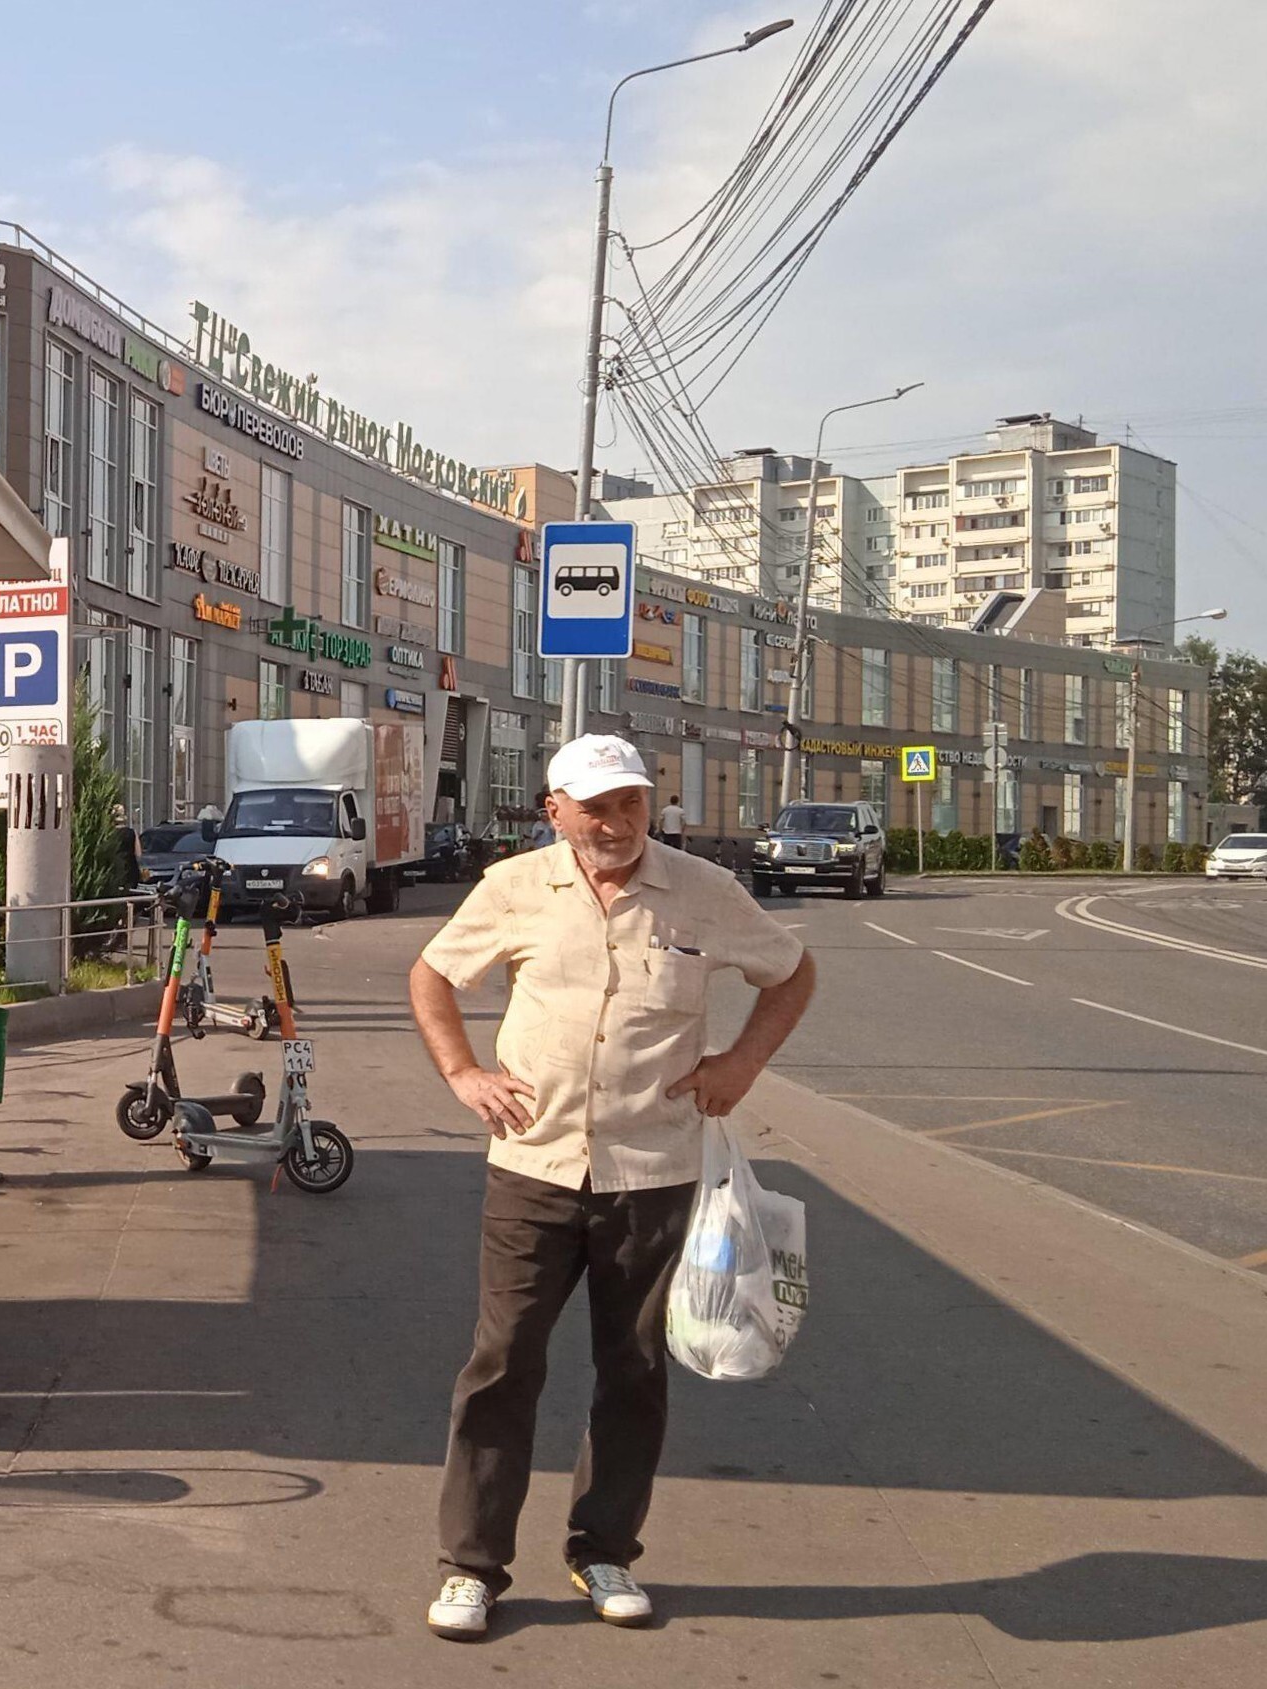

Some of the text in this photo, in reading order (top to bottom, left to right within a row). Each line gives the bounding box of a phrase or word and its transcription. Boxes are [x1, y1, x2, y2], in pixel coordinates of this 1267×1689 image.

[236, 403, 304, 460] ПЕРЕВОДОВ
[327, 398, 393, 466] рынок
[4, 643, 42, 697] P
[392, 646, 424, 669] ОПТИКА
[16, 725, 58, 737] 1 ЧАС
[288, 1058, 313, 1070] 114
